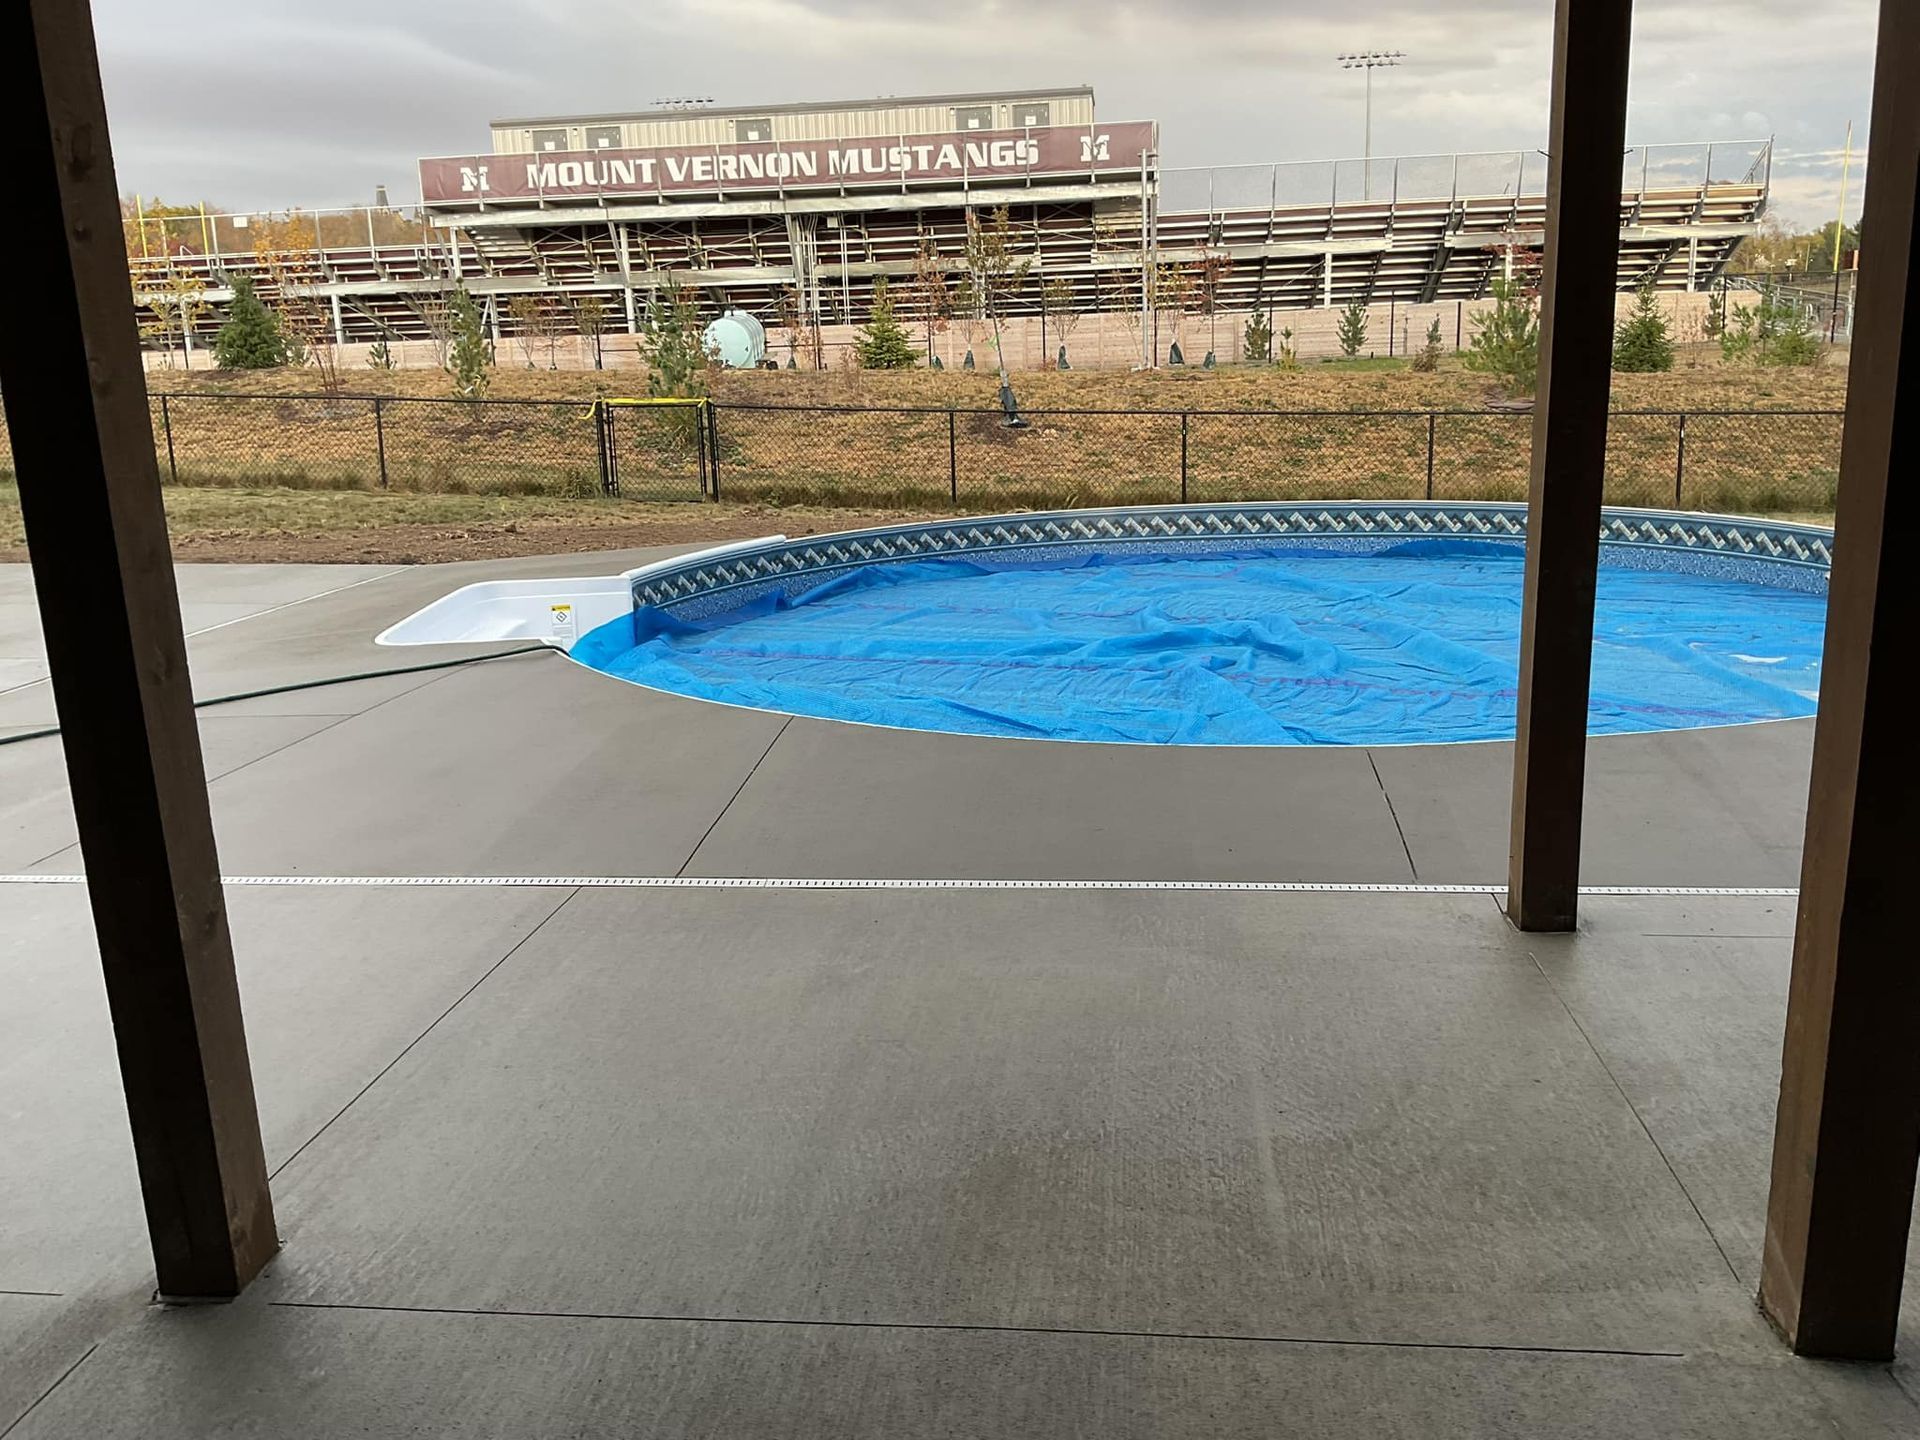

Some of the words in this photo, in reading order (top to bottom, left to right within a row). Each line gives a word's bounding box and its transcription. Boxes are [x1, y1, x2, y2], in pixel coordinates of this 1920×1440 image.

[526, 158, 657, 188] MOUNT
[665, 151, 817, 182] VERNON
[828, 139, 1039, 175] MUSTANGS
